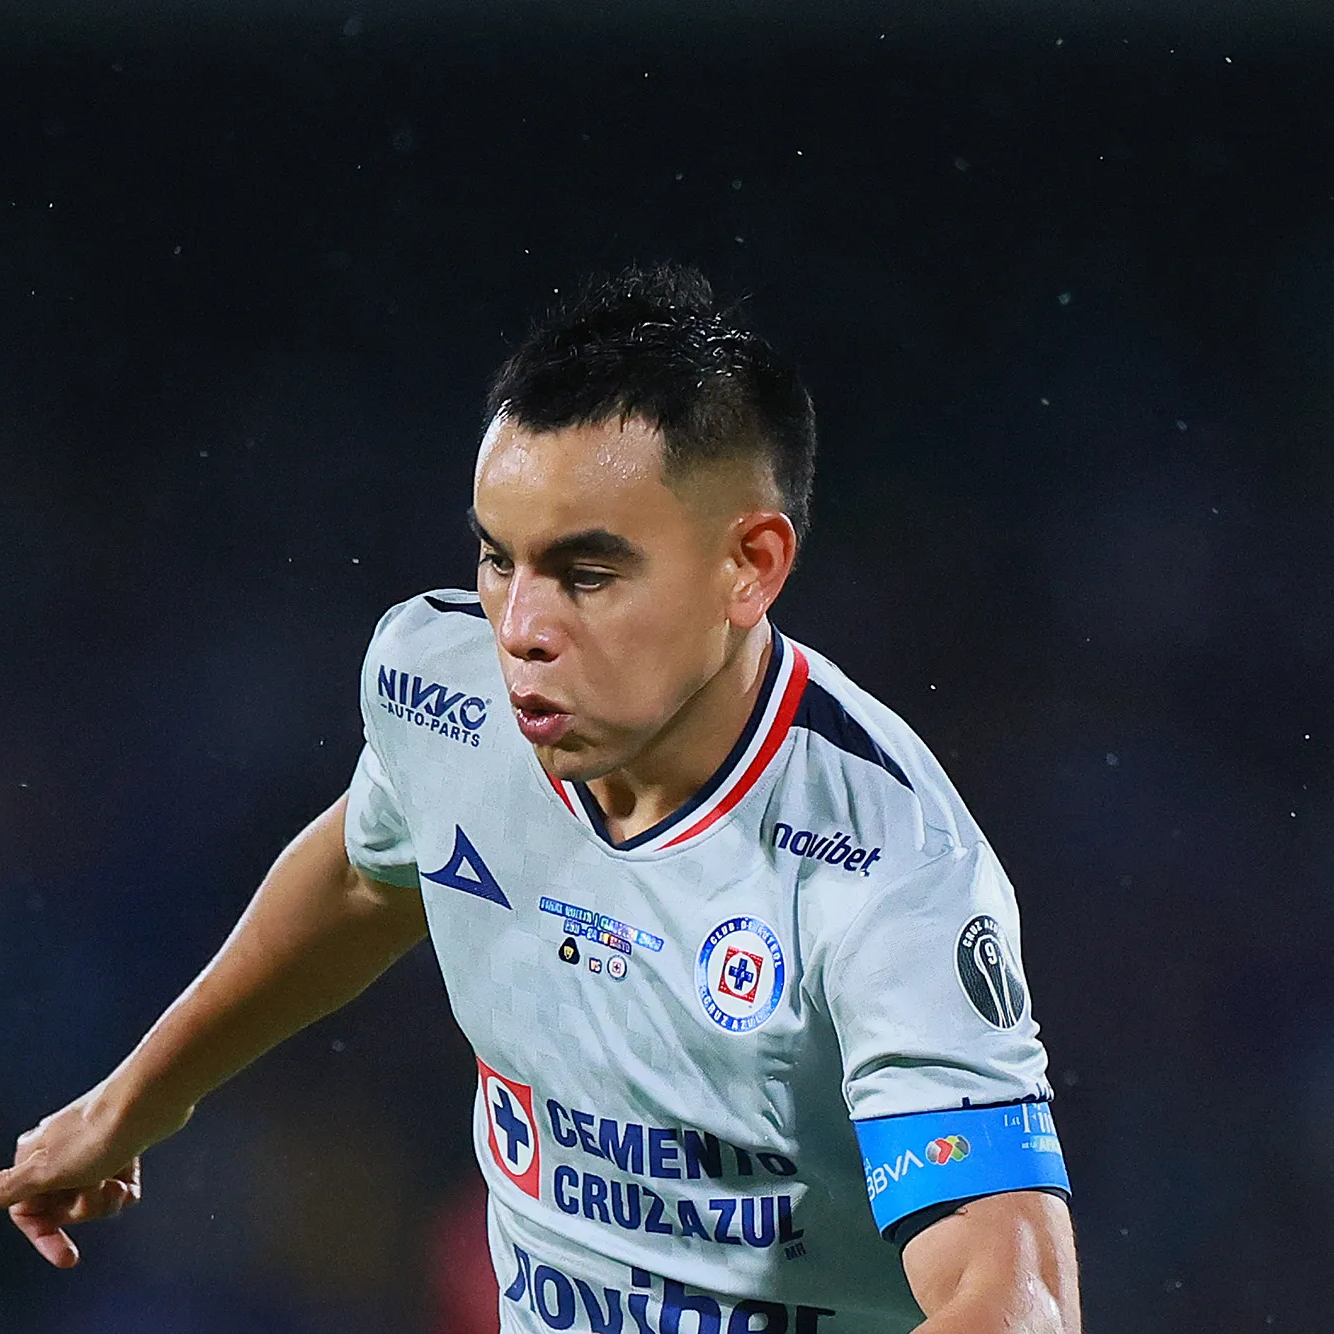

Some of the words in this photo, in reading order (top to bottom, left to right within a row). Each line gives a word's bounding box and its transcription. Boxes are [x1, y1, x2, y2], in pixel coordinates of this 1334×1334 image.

[772, 823, 881, 877] novibet
[709, 922, 735, 945] CLUB
[962, 921, 982, 948] CRUZ
[984, 918, 1000, 933] AZU
[703, 996, 729, 1026] CRUZ
[546, 1099, 798, 1179] CEMENTO
[553, 1165, 673, 1234] CRUZ
[677, 1195, 804, 1248] AZUL
